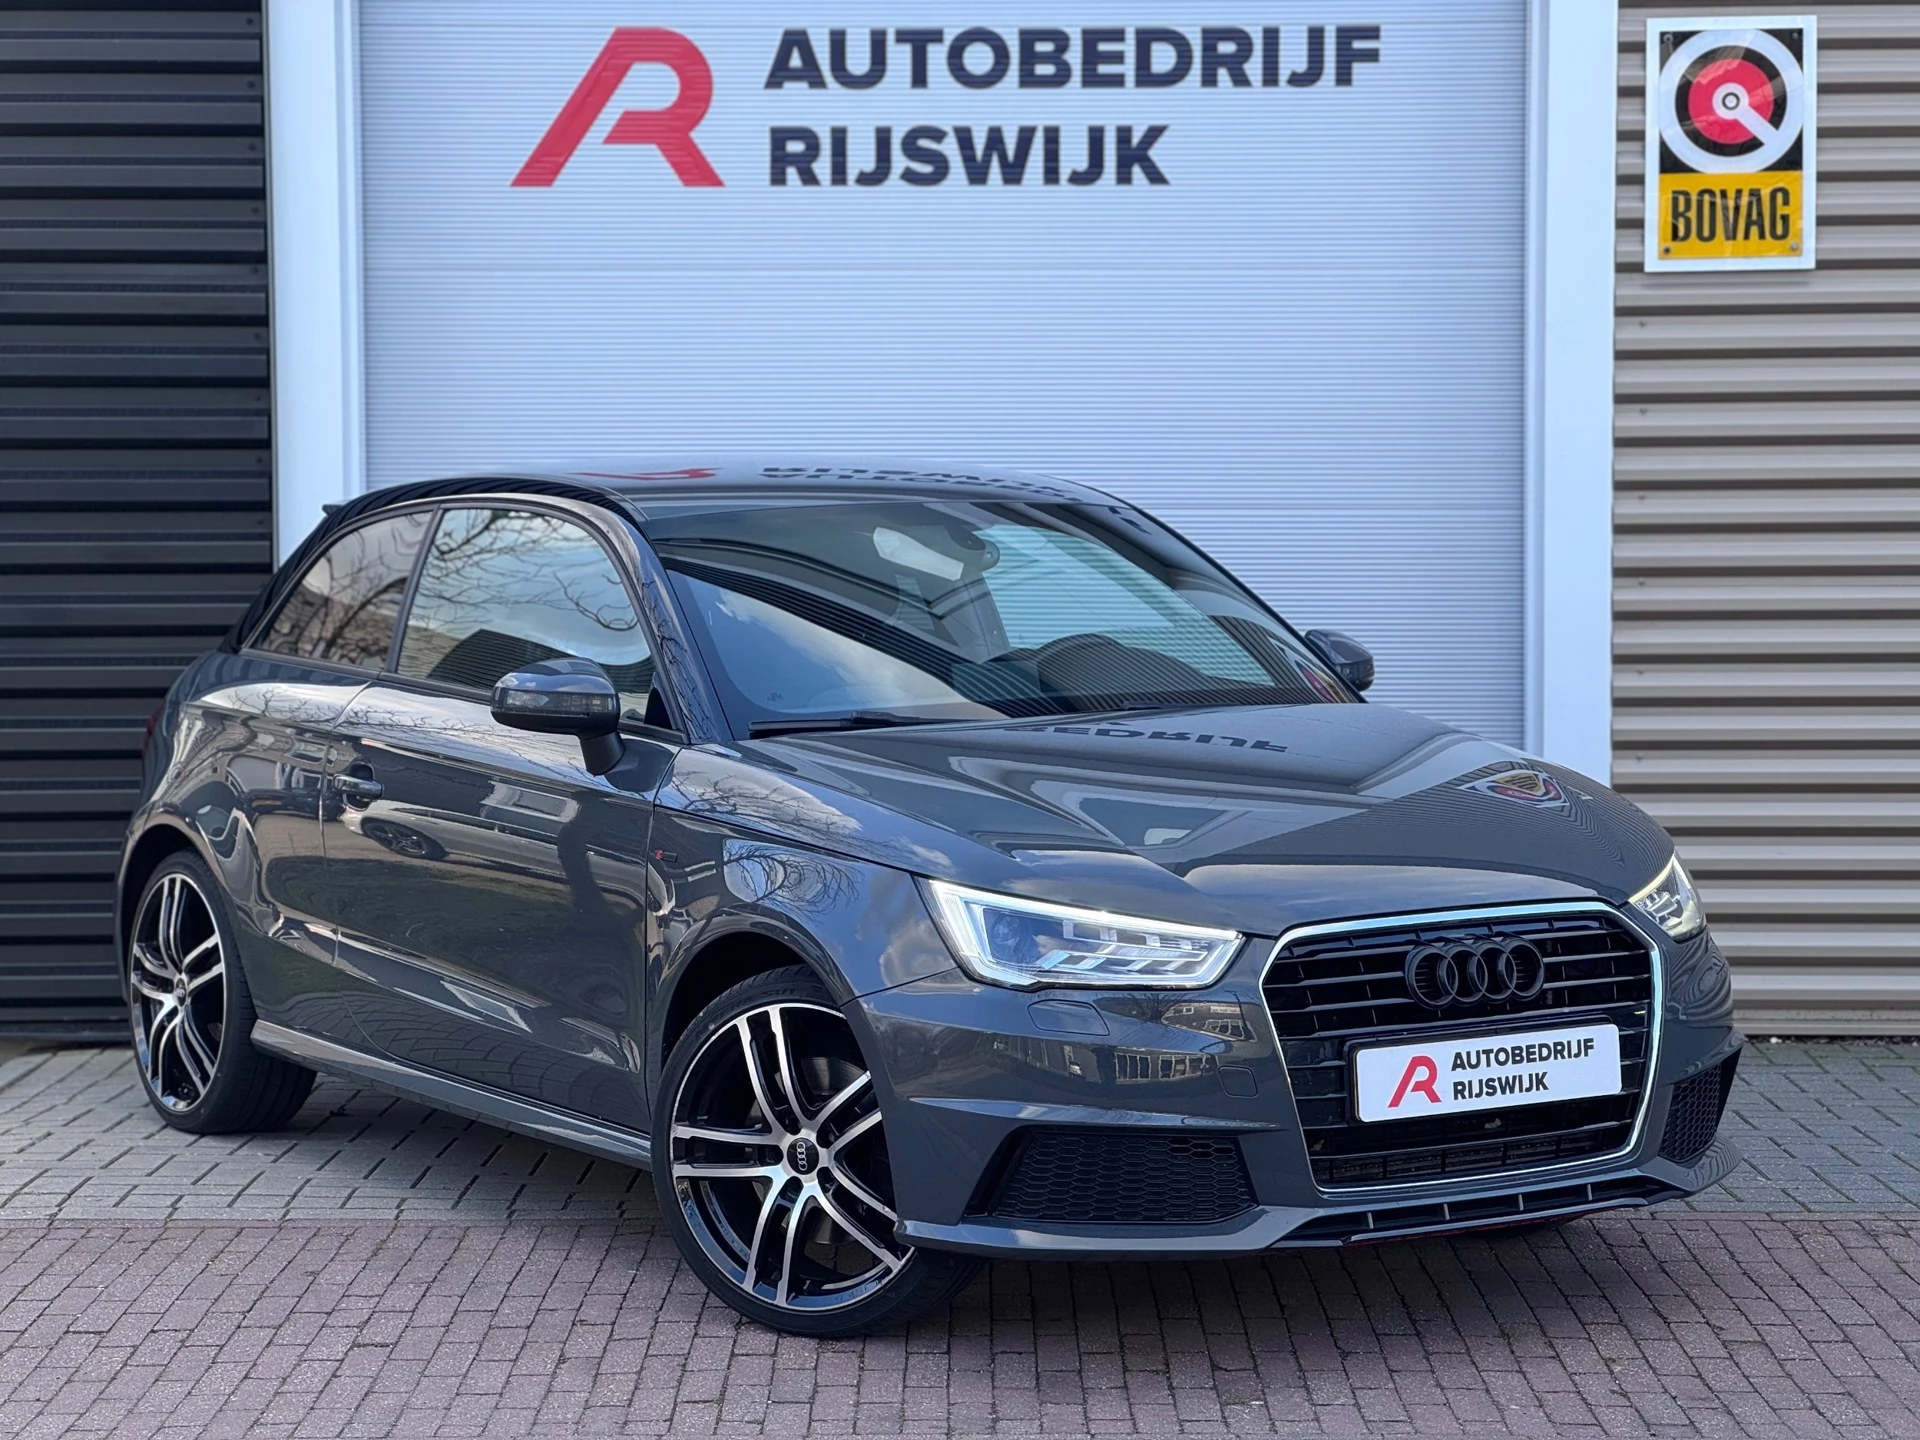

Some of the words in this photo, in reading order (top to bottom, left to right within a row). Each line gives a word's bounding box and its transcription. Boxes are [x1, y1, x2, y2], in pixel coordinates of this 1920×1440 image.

[765, 26, 1380, 89] AUTOBEDRIJF
[770, 126, 1169, 186] RIJSWIJK
[1671, 187, 1790, 242] BOVAG
[1451, 1038, 1594, 1071] AUTOBEDRIJF
[1453, 1071, 1549, 1100] RIJSWIJK
